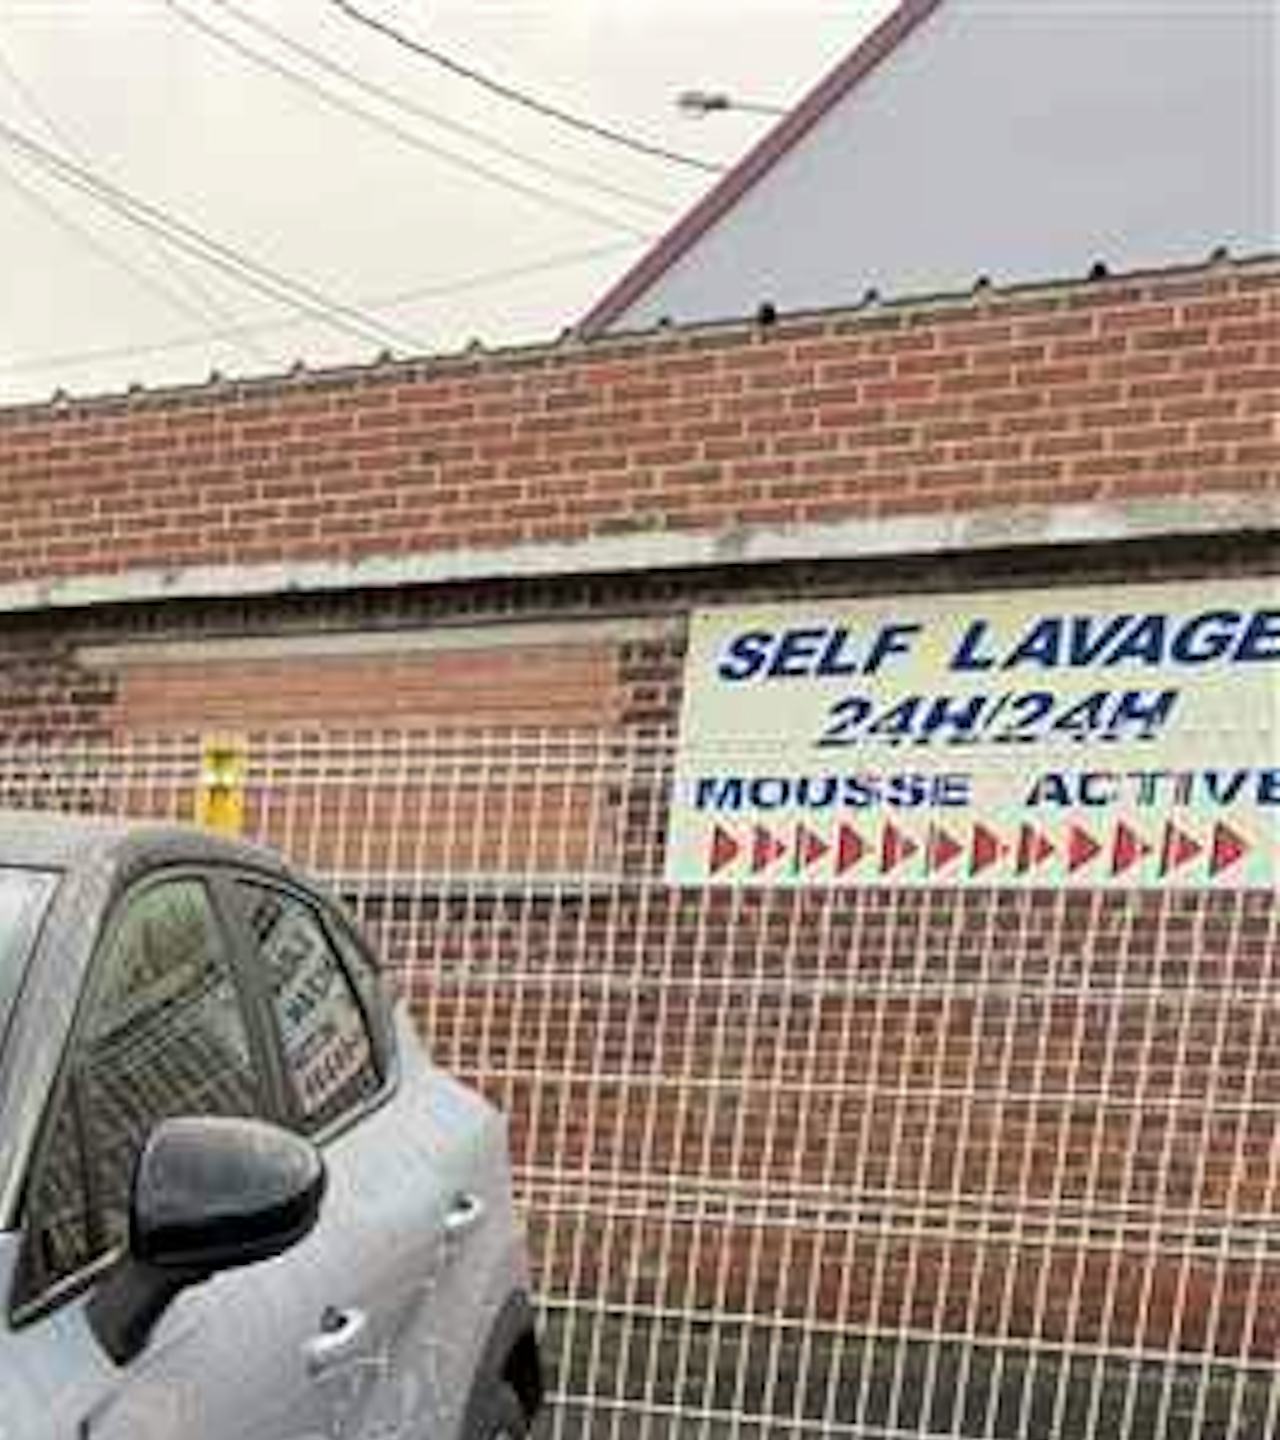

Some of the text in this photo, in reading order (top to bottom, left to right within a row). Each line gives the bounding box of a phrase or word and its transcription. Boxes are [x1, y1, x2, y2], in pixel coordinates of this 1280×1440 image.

[718, 610, 1280, 681] SELF LAVAGE
[817, 689, 1179, 748] 24H/24H
[694, 770, 1280, 811] MOUSSE ACTIVE
